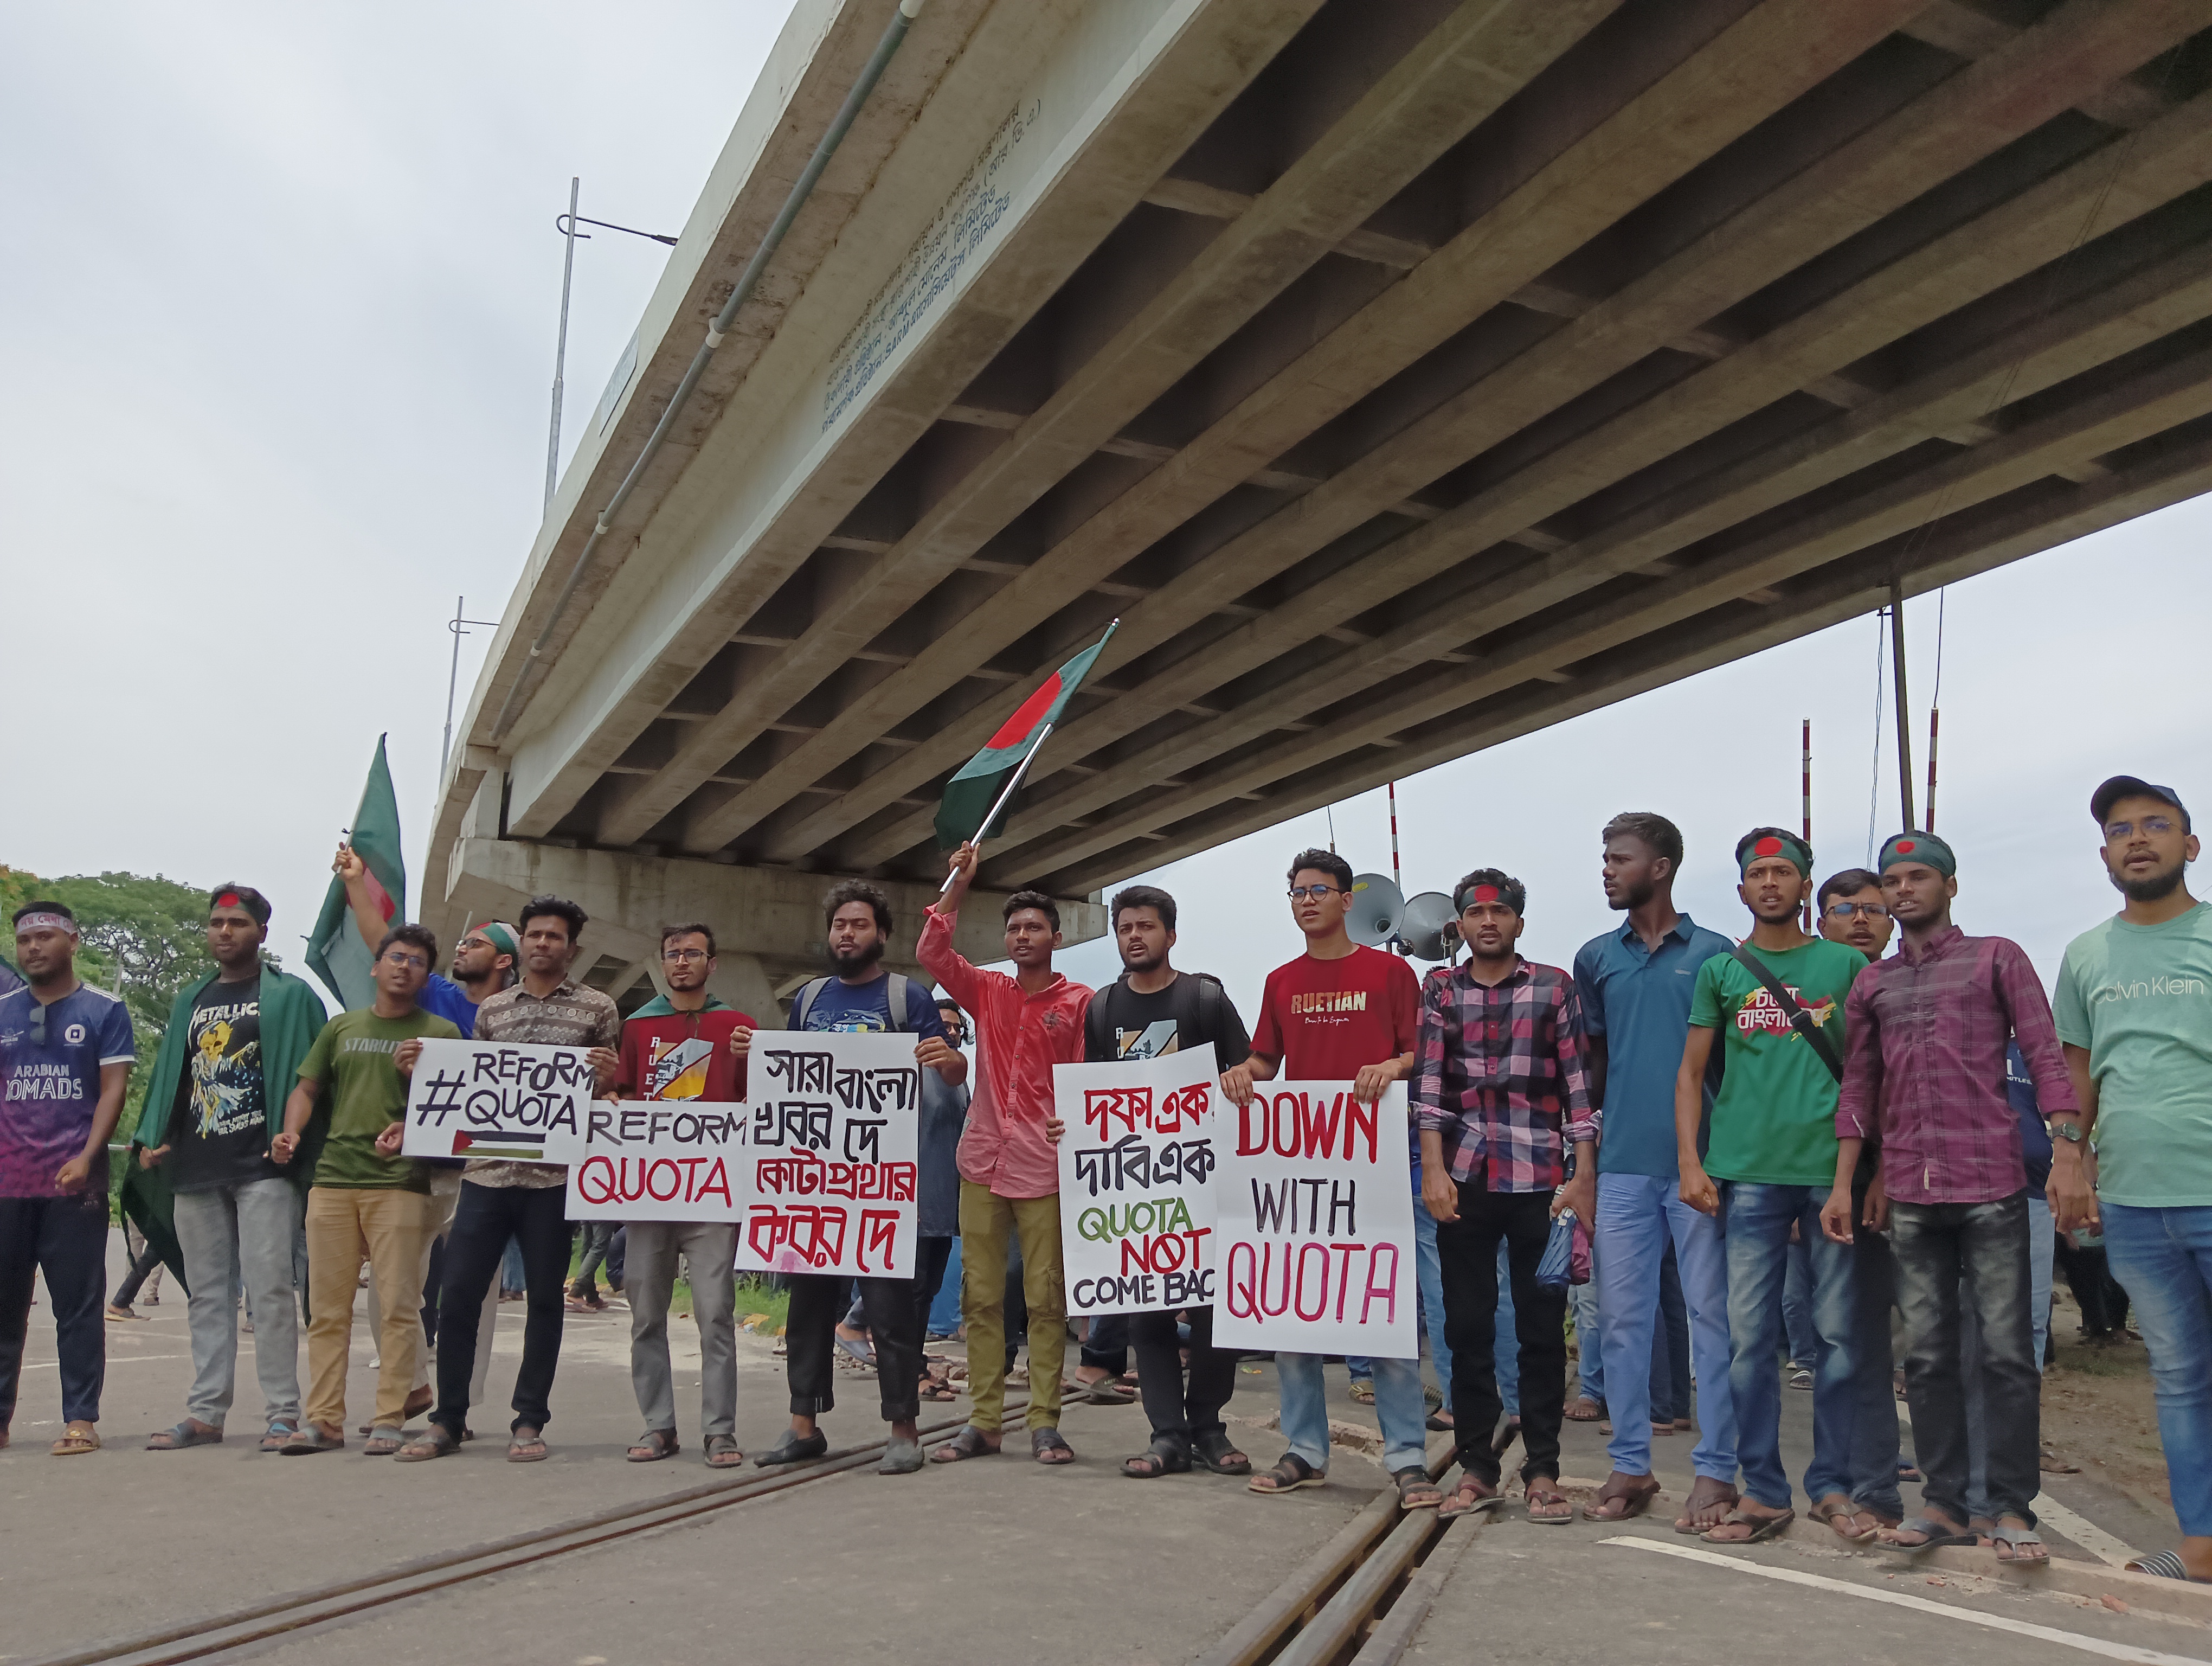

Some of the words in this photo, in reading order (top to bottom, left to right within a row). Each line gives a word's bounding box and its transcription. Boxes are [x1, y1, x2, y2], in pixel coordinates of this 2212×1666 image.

[938, 207, 943, 221] ও
[917, 246, 948, 296] মোনেম
[953, 184, 995, 249] লিমিটেড
[885, 320, 909, 360] SARM
[969, 191, 1010, 255] লিমিটেড
[1291, 991, 1366, 1014] RUETIAN
[2090, 979, 2148, 1004] Calvin
[2152, 974, 2204, 996] Klein
[189, 1002, 260, 1029] METALLIC
[14, 1063, 69, 1078] ARABIAN
[472, 1049, 596, 1092] REFORM
[764, 1049, 834, 1096] সারা
[834, 1067, 918, 1113] বাংলা
[587, 1111, 747, 1146] REFORM
[754, 1101, 833, 1150] খবর
[844, 1118, 888, 1165] দে
[1236, 1091, 1380, 1164] DOWN
[578, 1155, 732, 1208] QUOTA
[1077, 1196, 1194, 1243] QUOTA
[1251, 1177, 1356, 1236] WITH
[748, 1204, 847, 1268] কবর
[856, 1208, 901, 1273] দে
[1121, 1227, 1212, 1276] NOT
[1073, 1273, 1157, 1308] COME
[1227, 1241, 1399, 1325] QUOTA
